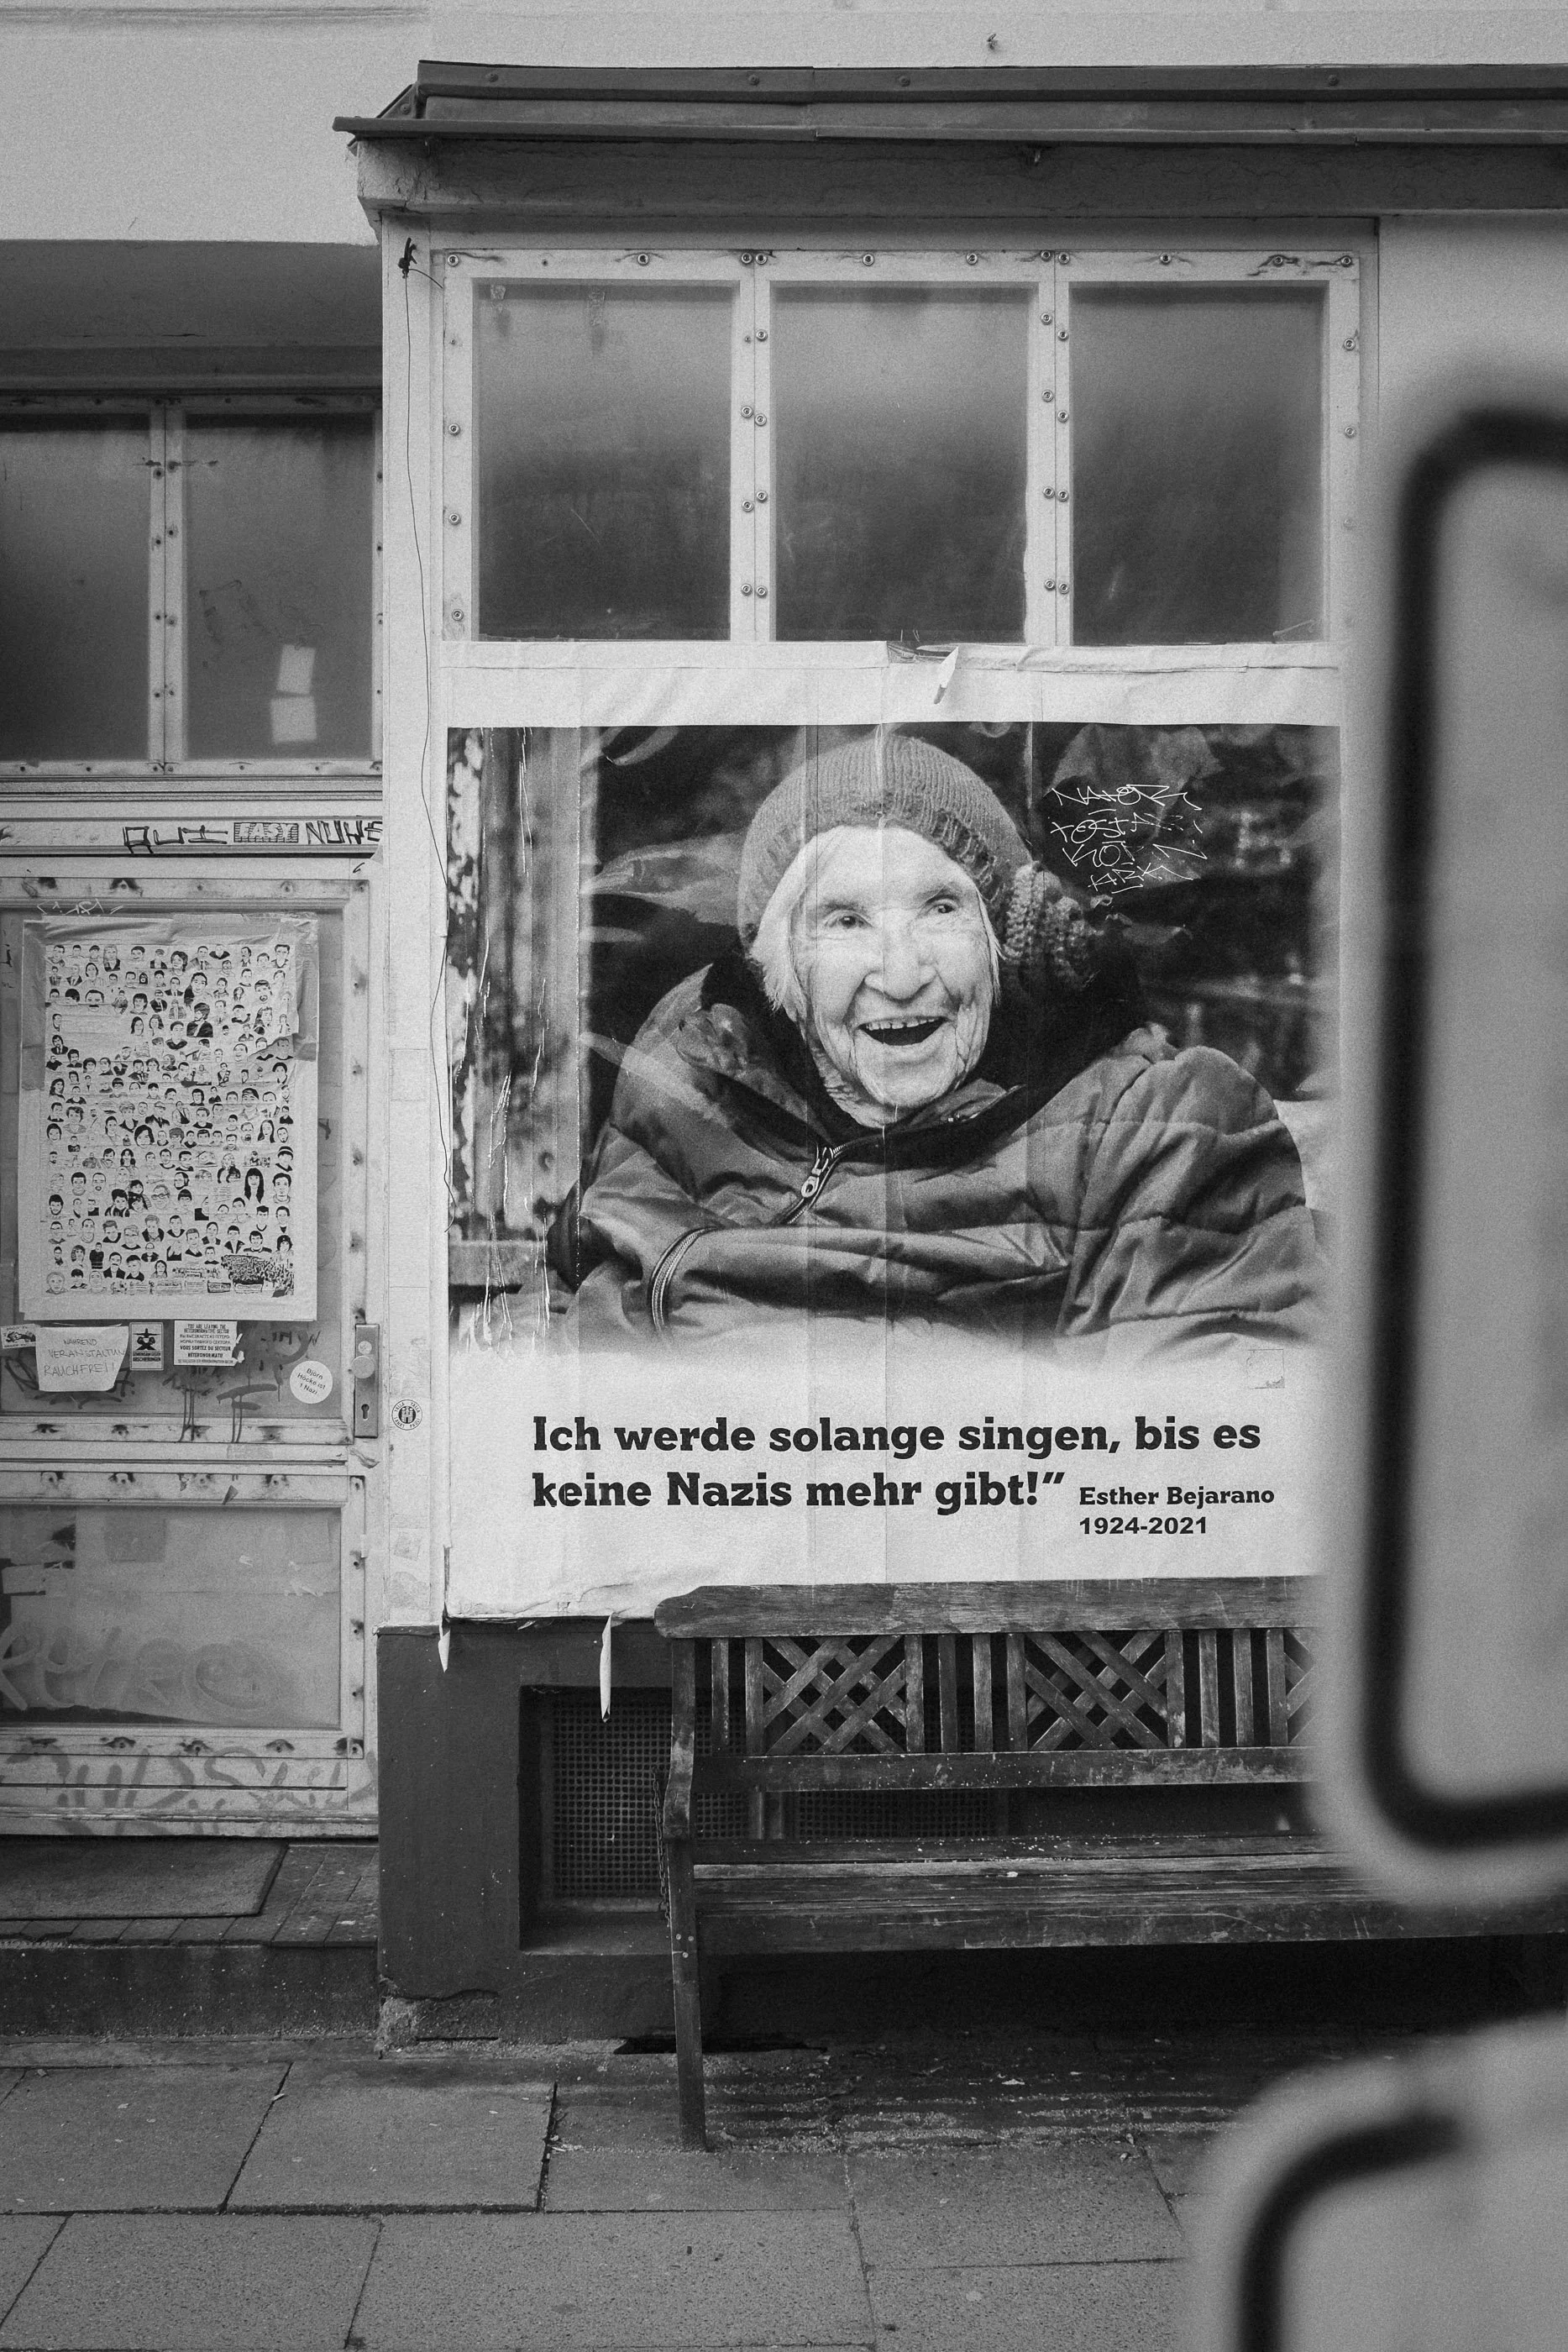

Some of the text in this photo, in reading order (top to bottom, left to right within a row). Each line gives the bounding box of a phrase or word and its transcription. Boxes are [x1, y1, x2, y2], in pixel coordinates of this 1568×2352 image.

[307, 1368, 323, 1380] Björn
[303, 1384, 317, 1395] Nazi
[533, 1416, 1260, 1459] Ich werde solange singen, bis es
[532, 1473, 651, 1507] keine
[668, 1472, 791, 1506] Nazis
[806, 1473, 921, 1506] mehr
[1080, 1486, 1275, 1509] Esther Bejarano
[1080, 1517, 1206, 1535] 1924-2021
